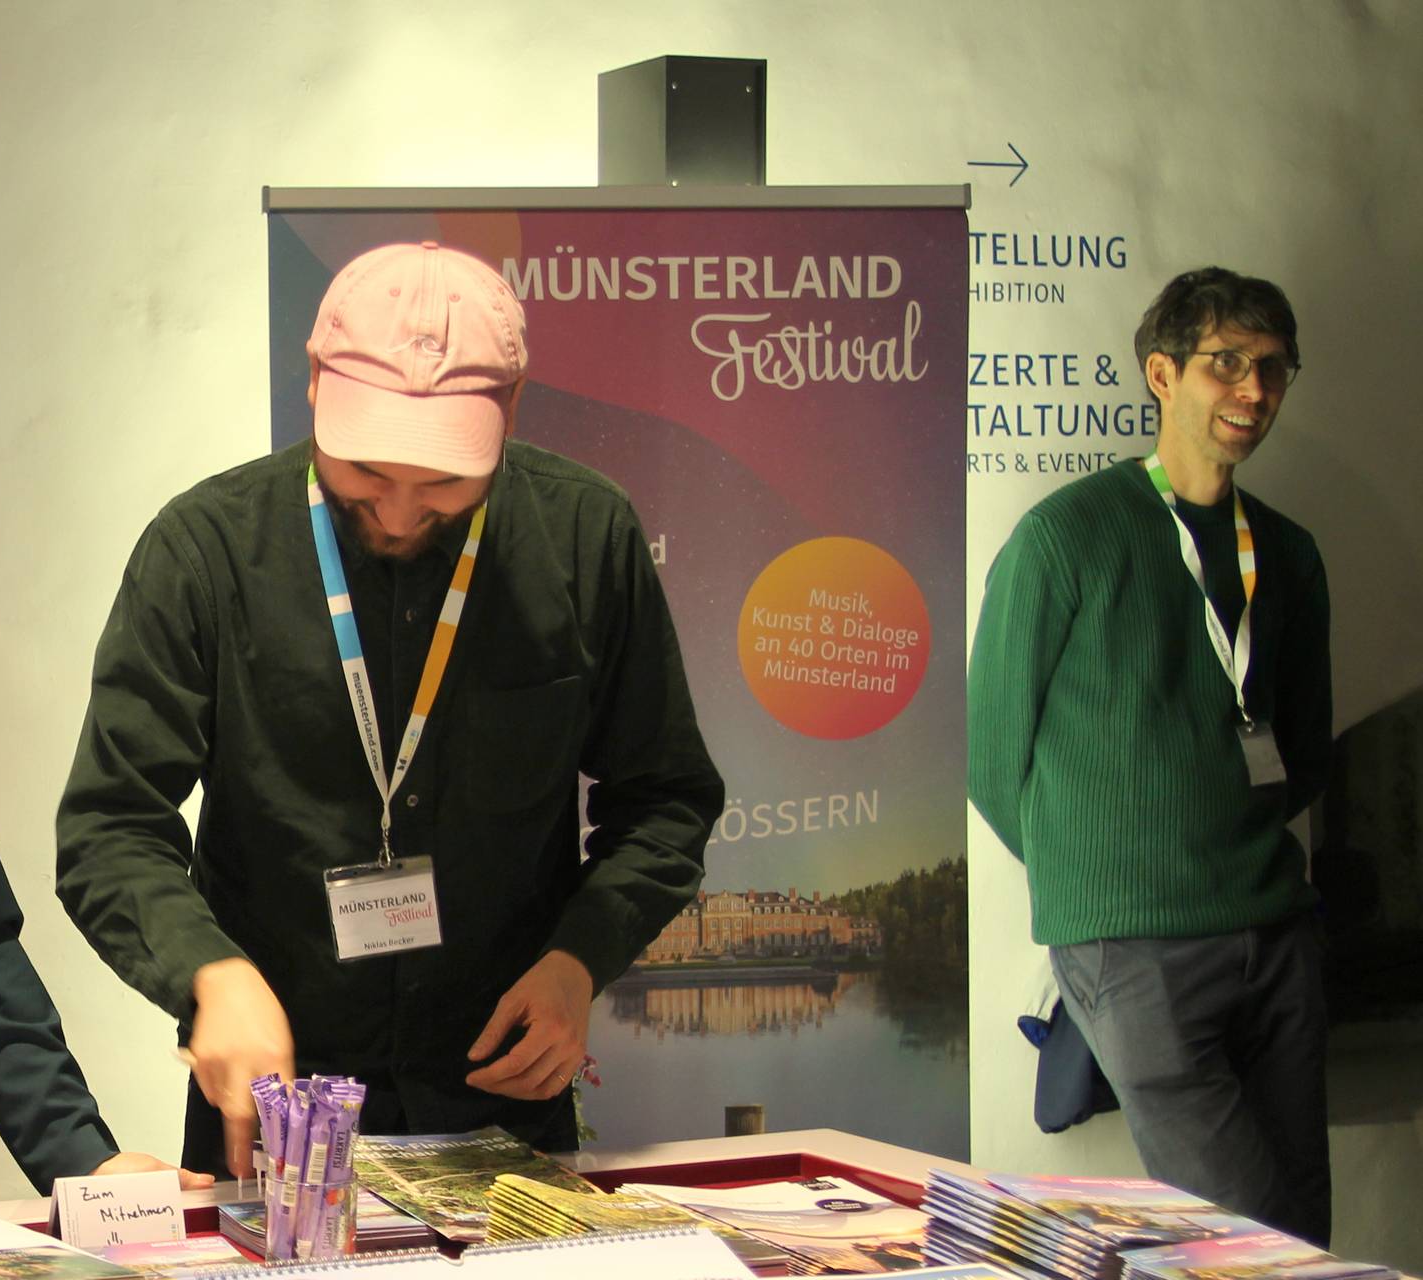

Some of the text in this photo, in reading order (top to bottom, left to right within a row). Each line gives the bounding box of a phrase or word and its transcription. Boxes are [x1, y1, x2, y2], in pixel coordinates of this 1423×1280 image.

[969, 233, 1127, 269] TELLUNG
[501, 246, 902, 301] MÜNSTERLAND
[969, 282, 1065, 303] HIBITION
[691, 300, 928, 401] Festival
[969, 354, 1120, 386] ZERTE &
[967, 404, 1156, 437] TALTUNGE
[967, 453, 1006, 473] RTS
[1015, 453, 1029, 473] &
[808, 588, 873, 618] Musik,
[752, 606, 918, 650] Kunst & Dialoge
[754, 636, 910, 670] an 40 Orten im
[763, 660, 896, 694] Münsterland
[705, 789, 878, 845] ÖSSERN
[339, 892, 426, 915] MÜNSTERLAND
[80, 1186, 114, 1201] Zum
[99, 1204, 175, 1222] Mitnehmen
